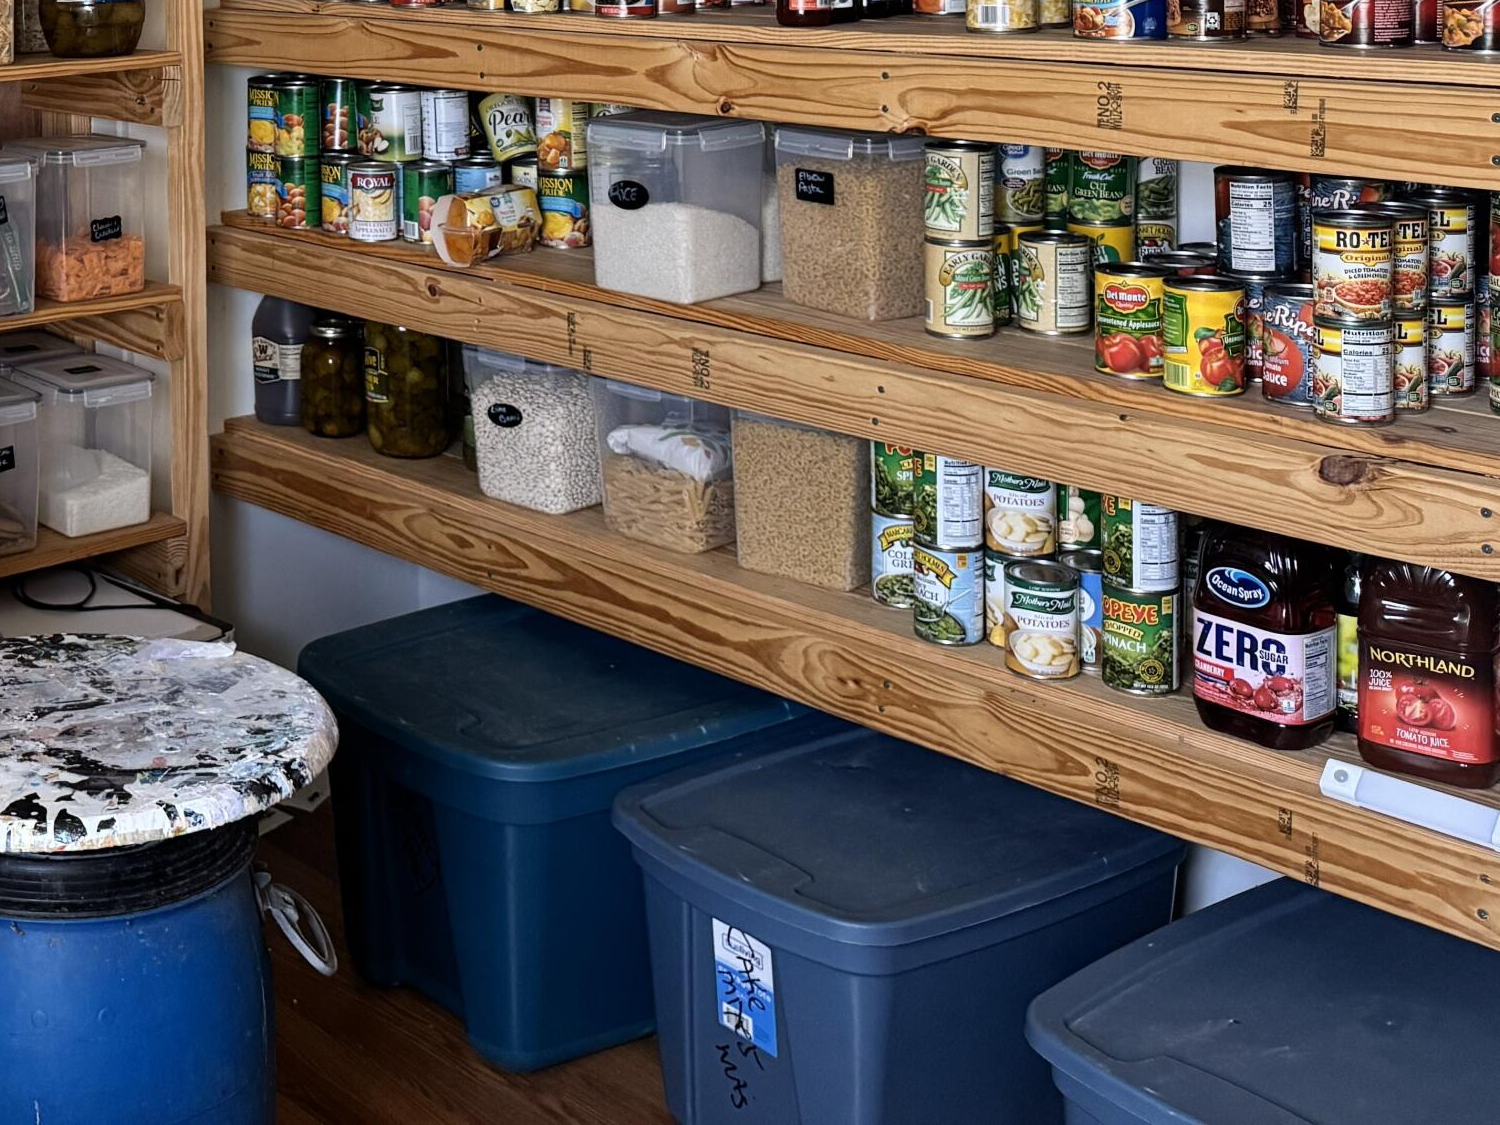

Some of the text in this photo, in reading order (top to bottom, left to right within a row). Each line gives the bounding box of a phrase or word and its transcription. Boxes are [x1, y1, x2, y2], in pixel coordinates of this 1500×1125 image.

[357, 177, 392, 189] ROYAL
[1089, 182, 1107, 191] CUT
[1075, 187, 1124, 199] GREEN BEANS
[1262, 200, 1273, 208] 25
[1344, 254, 1391, 263] Original
[1106, 290, 1147, 303] Del Monte
[993, 491, 1045, 507] POTATOES
[1211, 573, 1264, 602] Ocean Spray
[1017, 615, 1070, 629] POTATOES
[1195, 616, 1287, 677] ZERO
[1259, 648, 1289, 665] SUGAR
[1369, 645, 1476, 679] NORTHLAND
[1369, 668, 1393, 678] 100%
[1368, 677, 1392, 687] JUICE
[1396, 728, 1451, 748] TOMATO JUICE
